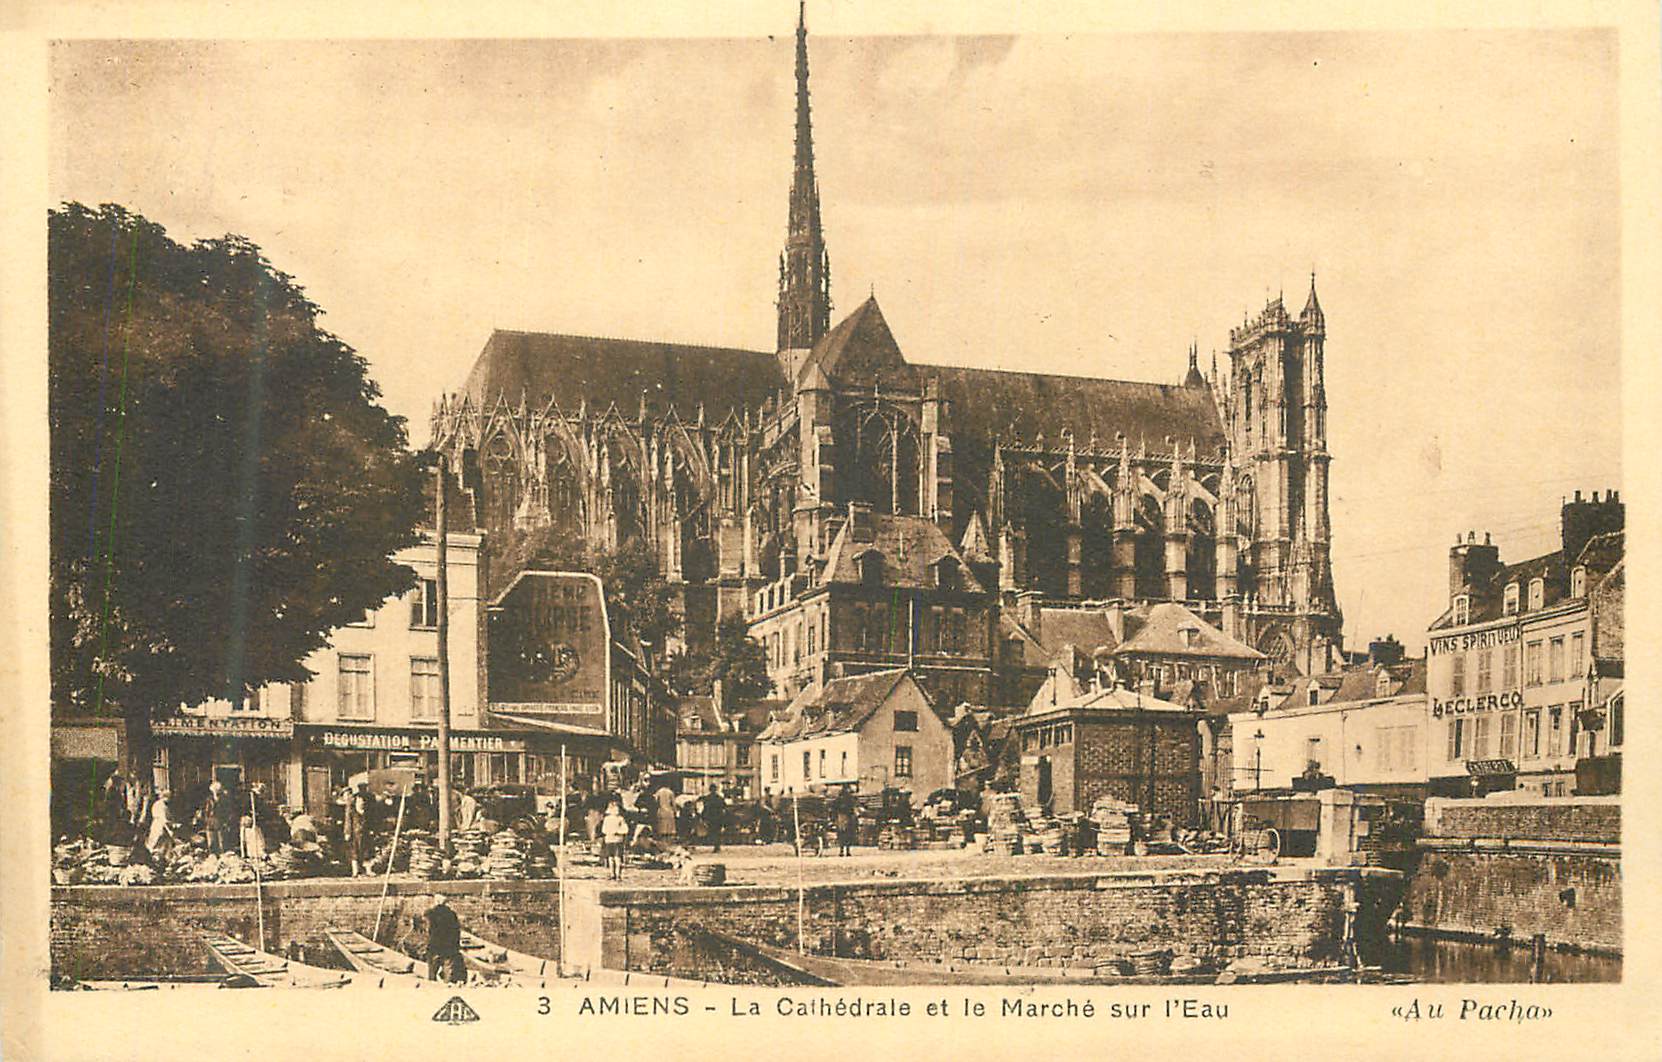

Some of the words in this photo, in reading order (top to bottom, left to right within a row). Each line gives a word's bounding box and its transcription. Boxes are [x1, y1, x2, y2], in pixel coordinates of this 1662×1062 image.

[1430, 638, 1458, 656] VINS
[1432, 690, 1524, 717] LECLERCQ
[419, 735, 503, 749] PAMENTIER
